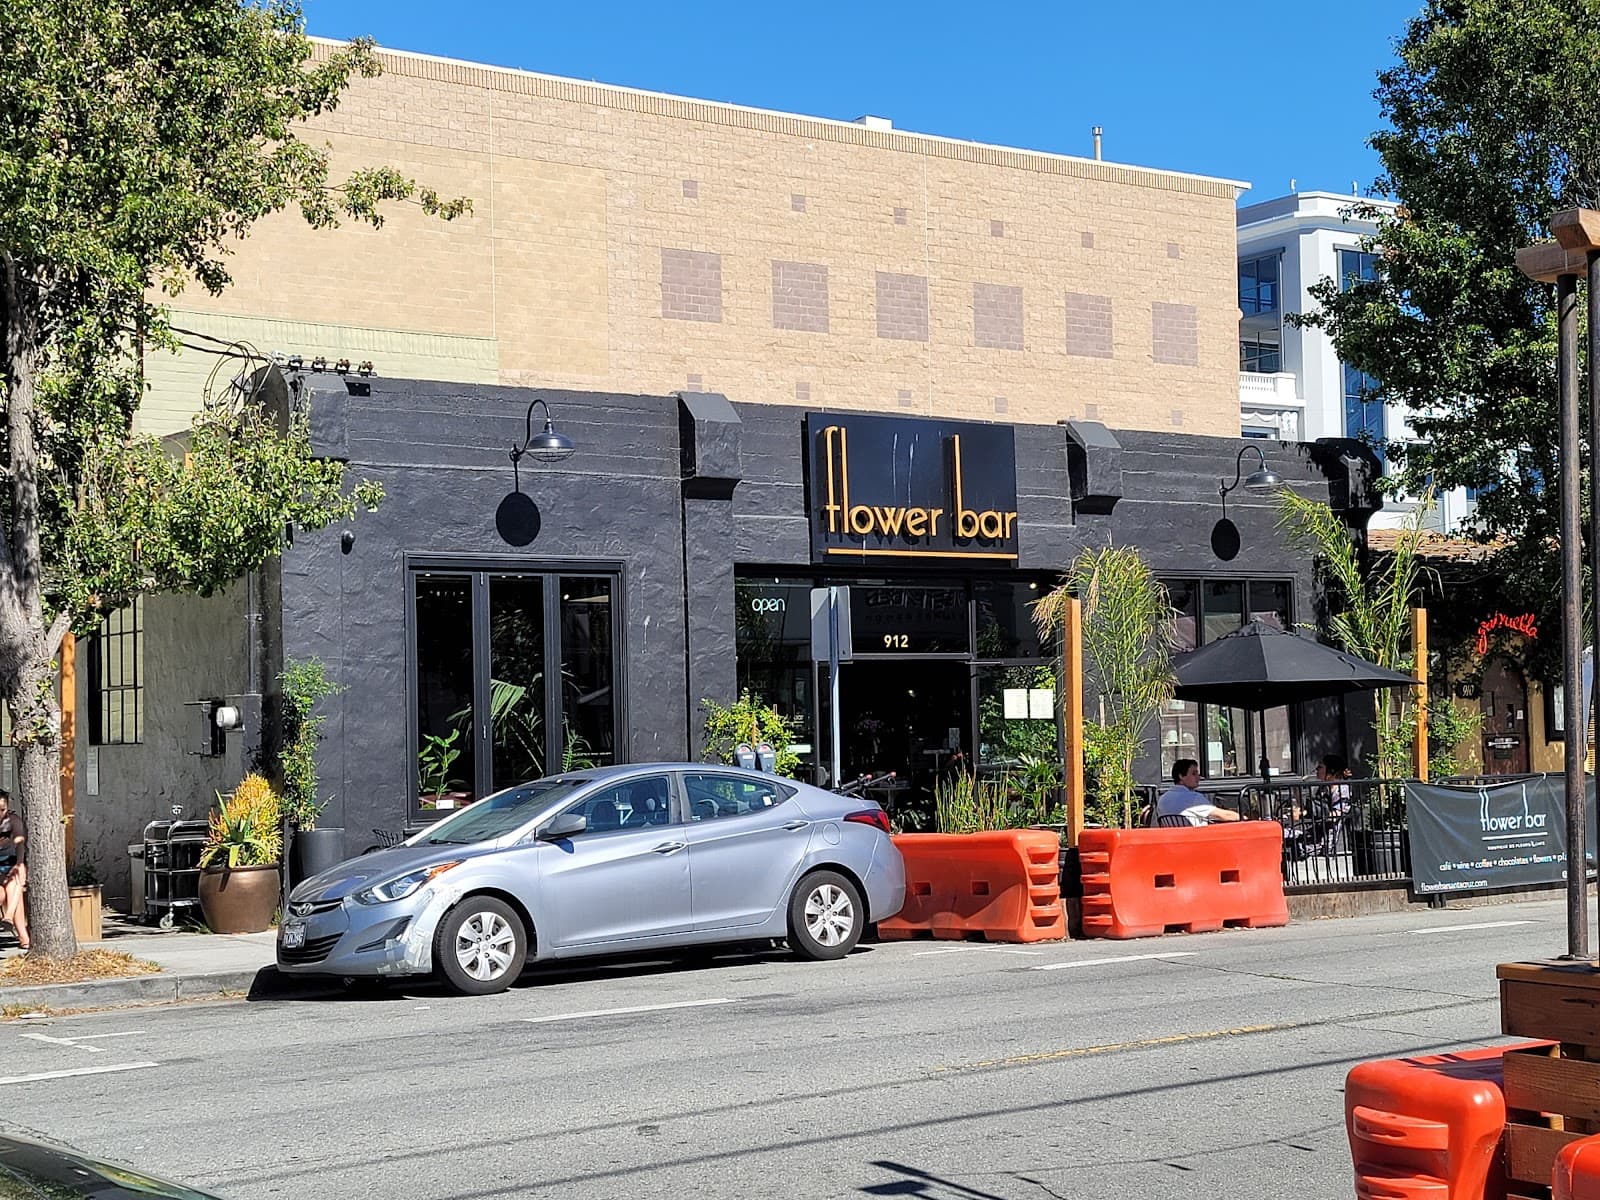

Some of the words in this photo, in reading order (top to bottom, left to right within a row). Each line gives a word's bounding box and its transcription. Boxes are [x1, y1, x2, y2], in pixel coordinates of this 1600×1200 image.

[824, 426, 943, 537] flower
[952, 434, 1017, 539] bar
[751, 598, 786, 616] open
[883, 634, 909, 648] 912
[1478, 788, 1522, 831] flower
[1522, 783, 1546, 828] bar
[1457, 861, 1470, 870] wine
[1475, 858, 1493, 869] coffee
[1498, 856, 1529, 867] chocolates
[1532, 853, 1552, 864] flowers
